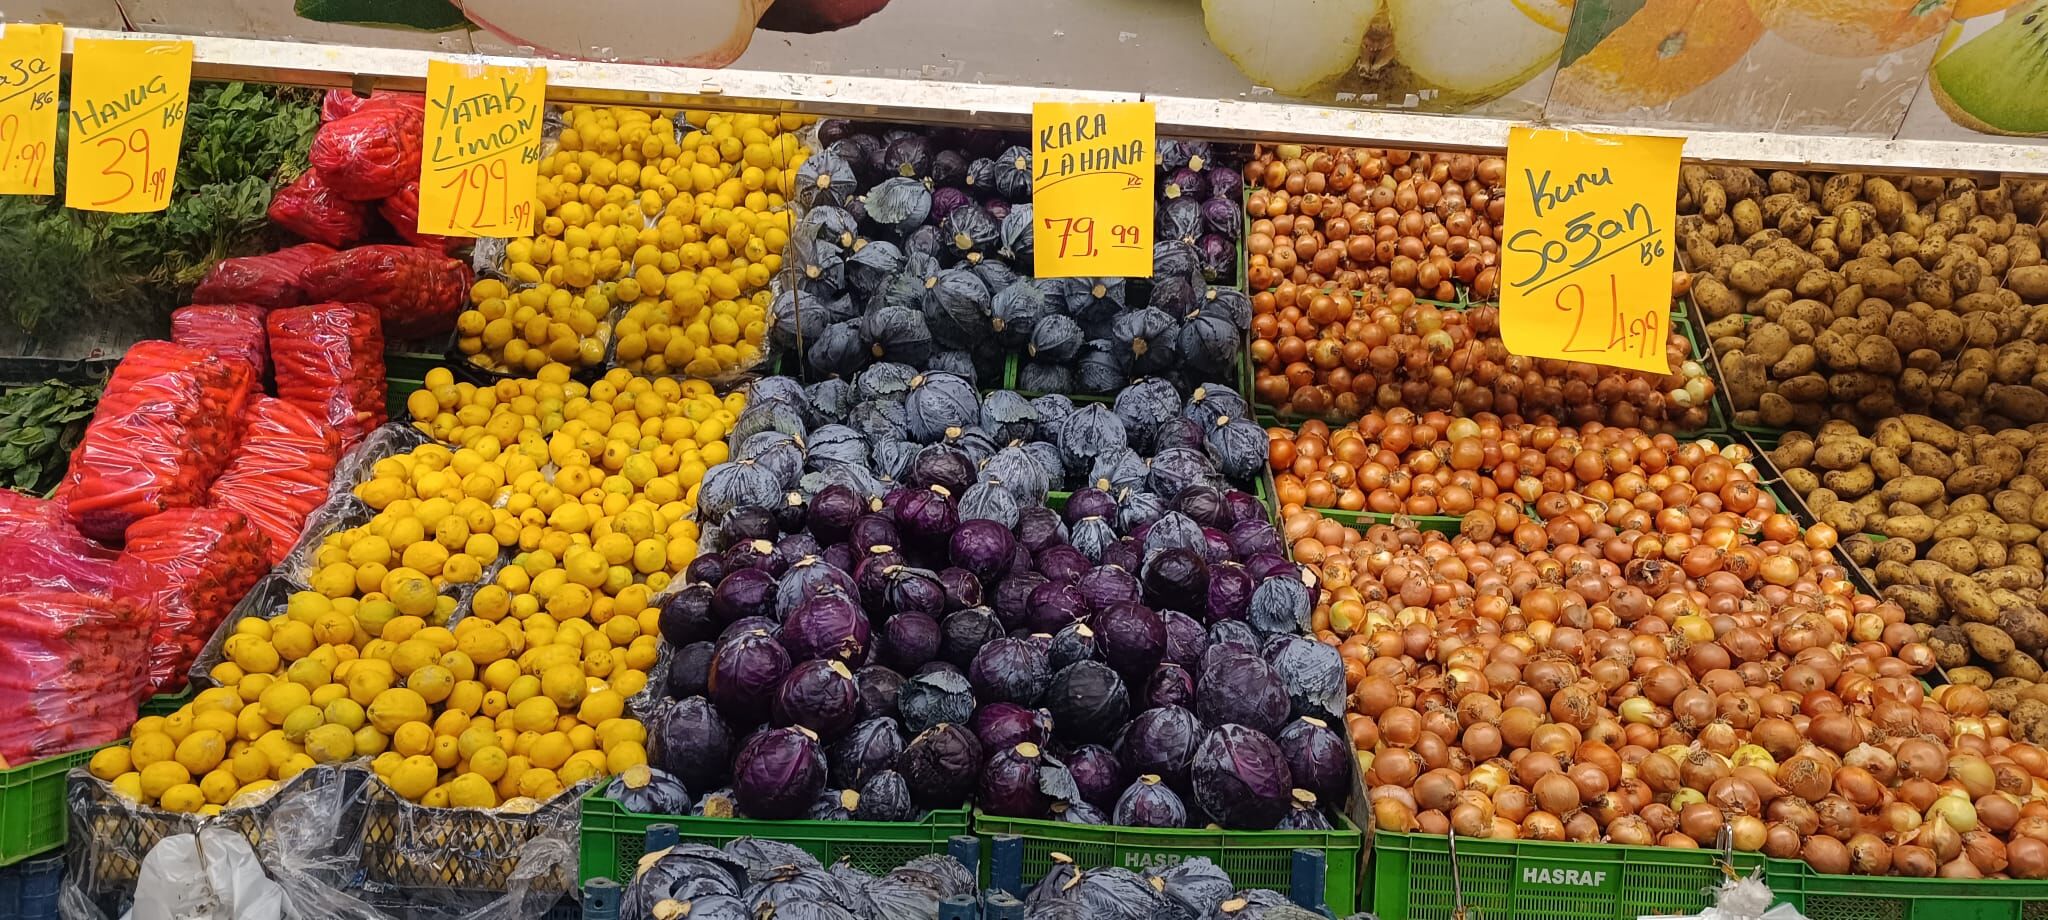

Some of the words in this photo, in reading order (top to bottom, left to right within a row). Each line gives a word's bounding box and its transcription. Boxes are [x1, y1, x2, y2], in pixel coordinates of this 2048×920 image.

[162, 101, 185, 130] KG
[432, 78, 526, 130] YATAK
[1040, 113, 1107, 153] KARA
[1035, 139, 1147, 182] LAHANA
[1522, 867, 1607, 887] HASRAF
